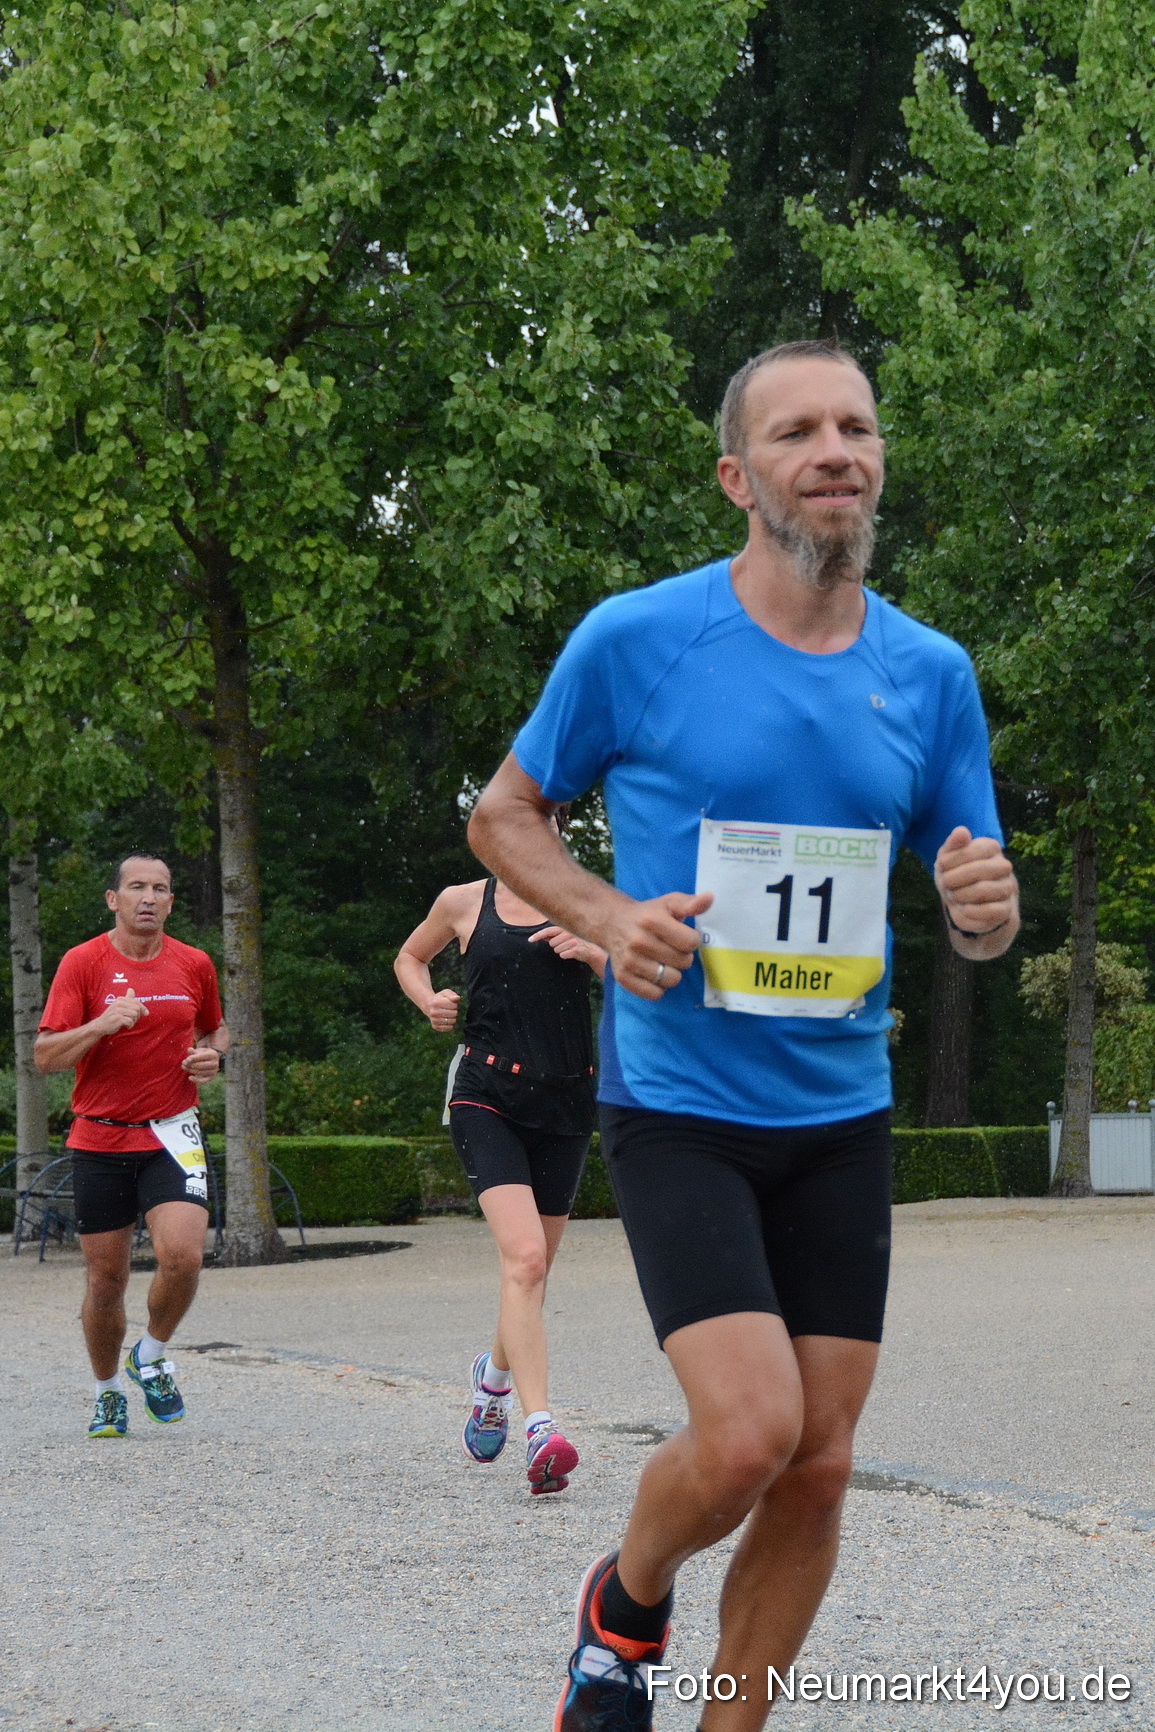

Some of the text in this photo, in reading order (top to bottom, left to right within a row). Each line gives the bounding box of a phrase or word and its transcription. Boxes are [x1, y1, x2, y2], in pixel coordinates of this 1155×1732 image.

[717, 843, 782, 858] NeuerMarkt
[794, 834, 878, 860] BOCK
[765, 874, 834, 944] 11
[754, 961, 833, 990] Maher
